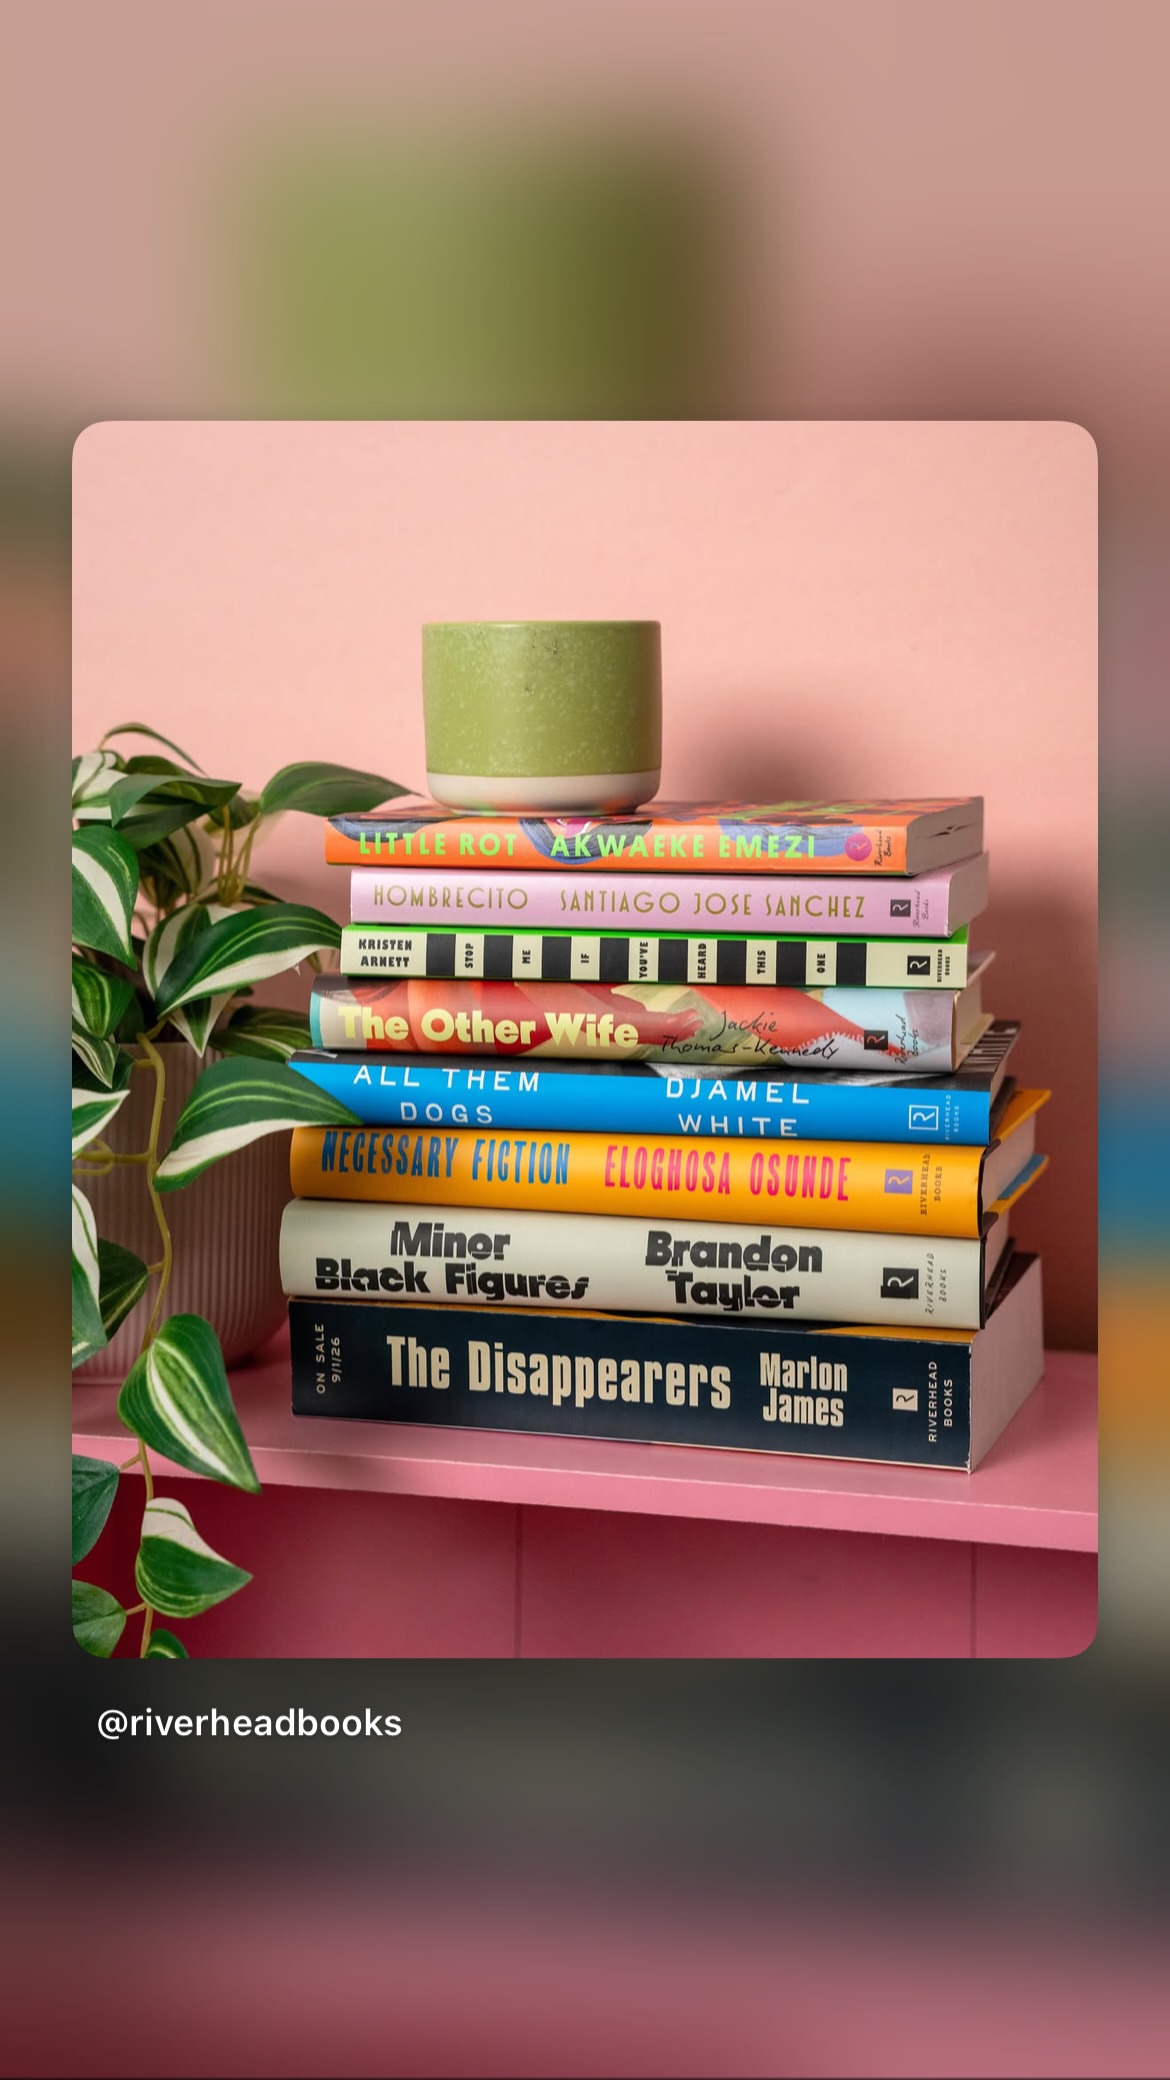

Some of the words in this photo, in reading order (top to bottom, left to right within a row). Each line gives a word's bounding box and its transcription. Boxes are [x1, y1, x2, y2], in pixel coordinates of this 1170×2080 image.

[359, 832, 446, 855] LITTLE
[459, 833, 517, 856] ROT
[550, 834, 704, 858] AKWAEKE
[719, 835, 815, 859] EMEZI
[374, 884, 528, 910] HOMBRECITO
[561, 889, 680, 914] SANTIAGO
[694, 893, 752, 916] JOSE
[765, 895, 865, 918] SANCHEZ
[358, 939, 412, 951] KRISTEN
[361, 956, 409, 968] ARNETT
[465, 943, 474, 968] STOP
[522, 949, 531, 964] ME
[581, 952, 589, 964] IF
[639, 941, 648, 978] YOU'VE
[697, 943, 706, 978] HEARD
[757, 950, 766, 975] THIS
[817, 953, 826, 973] ONE
[338, 1006, 409, 1040] The
[421, 1008, 536, 1045] Other
[544, 1012, 639, 1048] Wife
[709, 1010, 779, 1041] Jackie
[661, 1035, 840, 1060] Thomas-Kennedy
[353, 1065, 420, 1087] ALL
[442, 1068, 540, 1092] THEM
[666, 1078, 810, 1104] DJAMEL
[400, 1102, 493, 1124] DOGS
[677, 1113, 798, 1137] WHITE
[321, 1130, 459, 1178] NECESSARY
[472, 1139, 570, 1185] FICTION
[604, 1145, 731, 1195] ELOGHOSA
[750, 1152, 851, 1201] OSUNDE
[920, 1154, 930, 1215] RIVERHEAD
[934, 1166, 942, 1202] BOOKS
[390, 1220, 511, 1260] Minor
[645, 1230, 823, 1273] Brandon
[315, 1257, 431, 1294] Black
[444, 1262, 590, 1301] Figures
[665, 1270, 800, 1312] Taylor
[925, 1253, 934, 1314] RIVERHEAD
[939, 1268, 947, 1302] BOOKS
[315, 1323, 325, 1363] SALE
[331, 1337, 341, 1383] 9/1/26
[316, 1373, 325, 1394] ON
[386, 1335, 450, 1390] The
[468, 1340, 731, 1410] Disappearers
[760, 1352, 848, 1392] Marlon
[763, 1388, 844, 1427] James
[928, 1361, 937, 1442] RIVERHEAD
[943, 1379, 953, 1427] BOOKS
